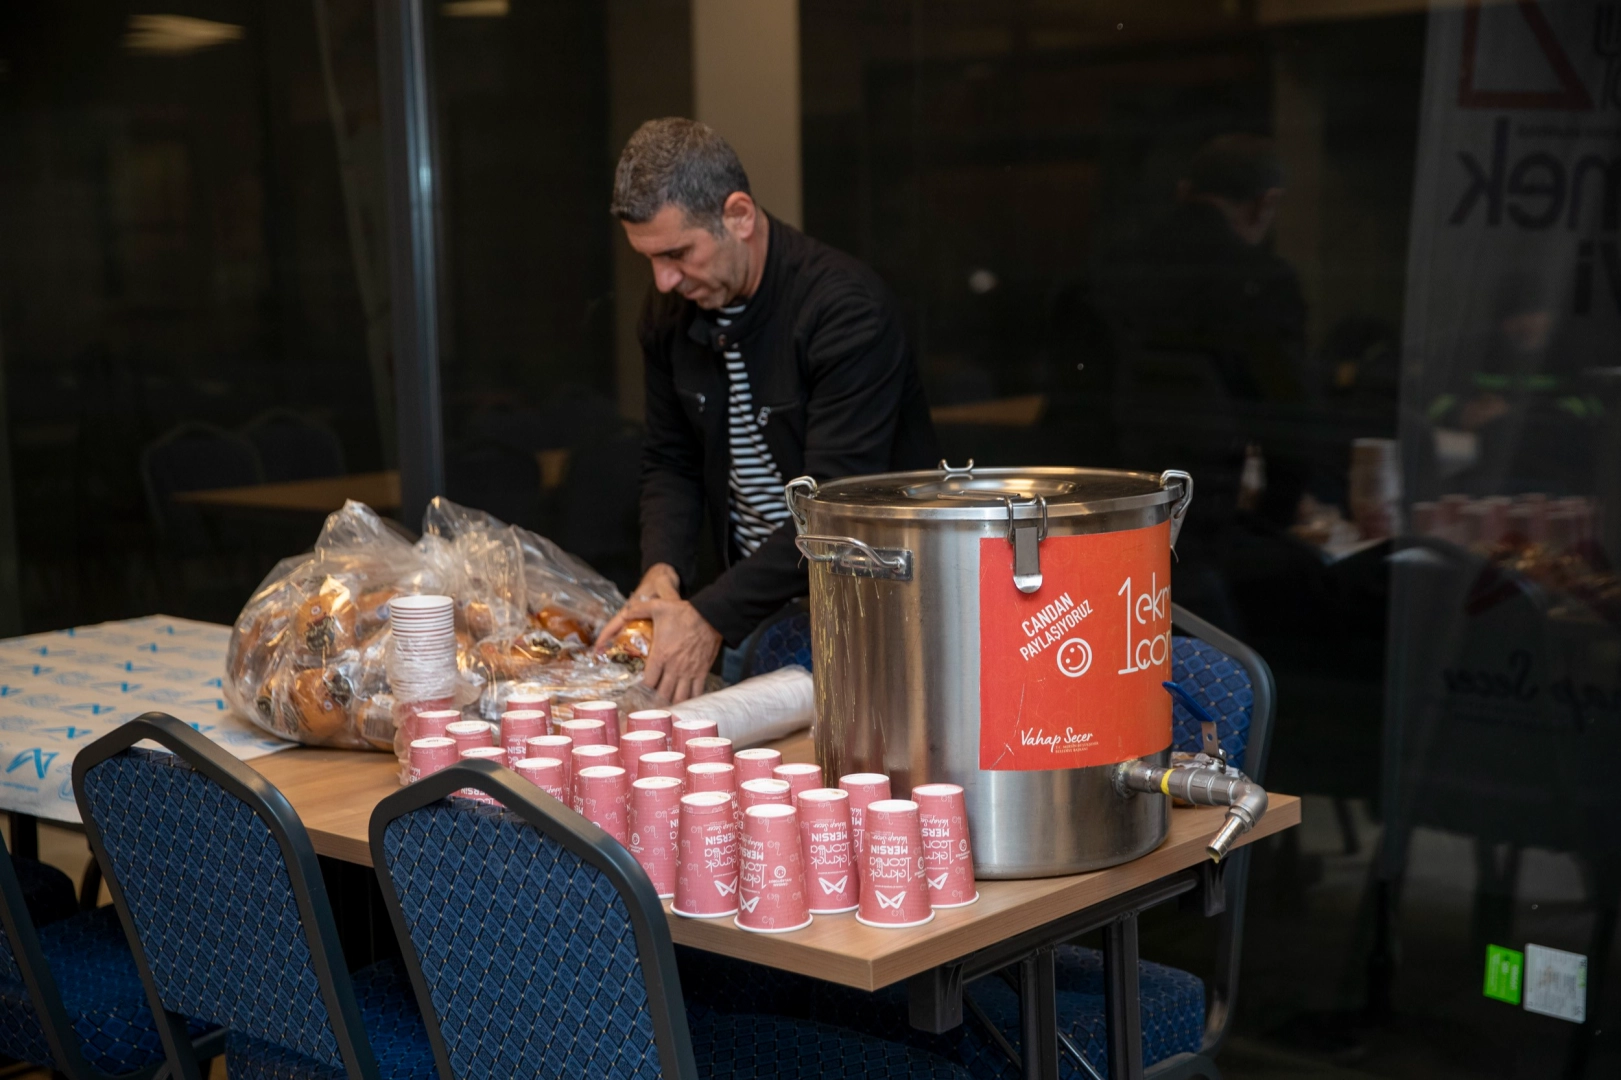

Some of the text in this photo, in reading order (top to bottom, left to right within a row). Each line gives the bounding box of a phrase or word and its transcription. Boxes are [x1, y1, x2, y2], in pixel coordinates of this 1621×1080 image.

[1019, 599, 1093, 661] PAYLAŞIYORUZ
[1021, 592, 1074, 637] CANDAN
[1021, 727, 1061, 753] Vahap
